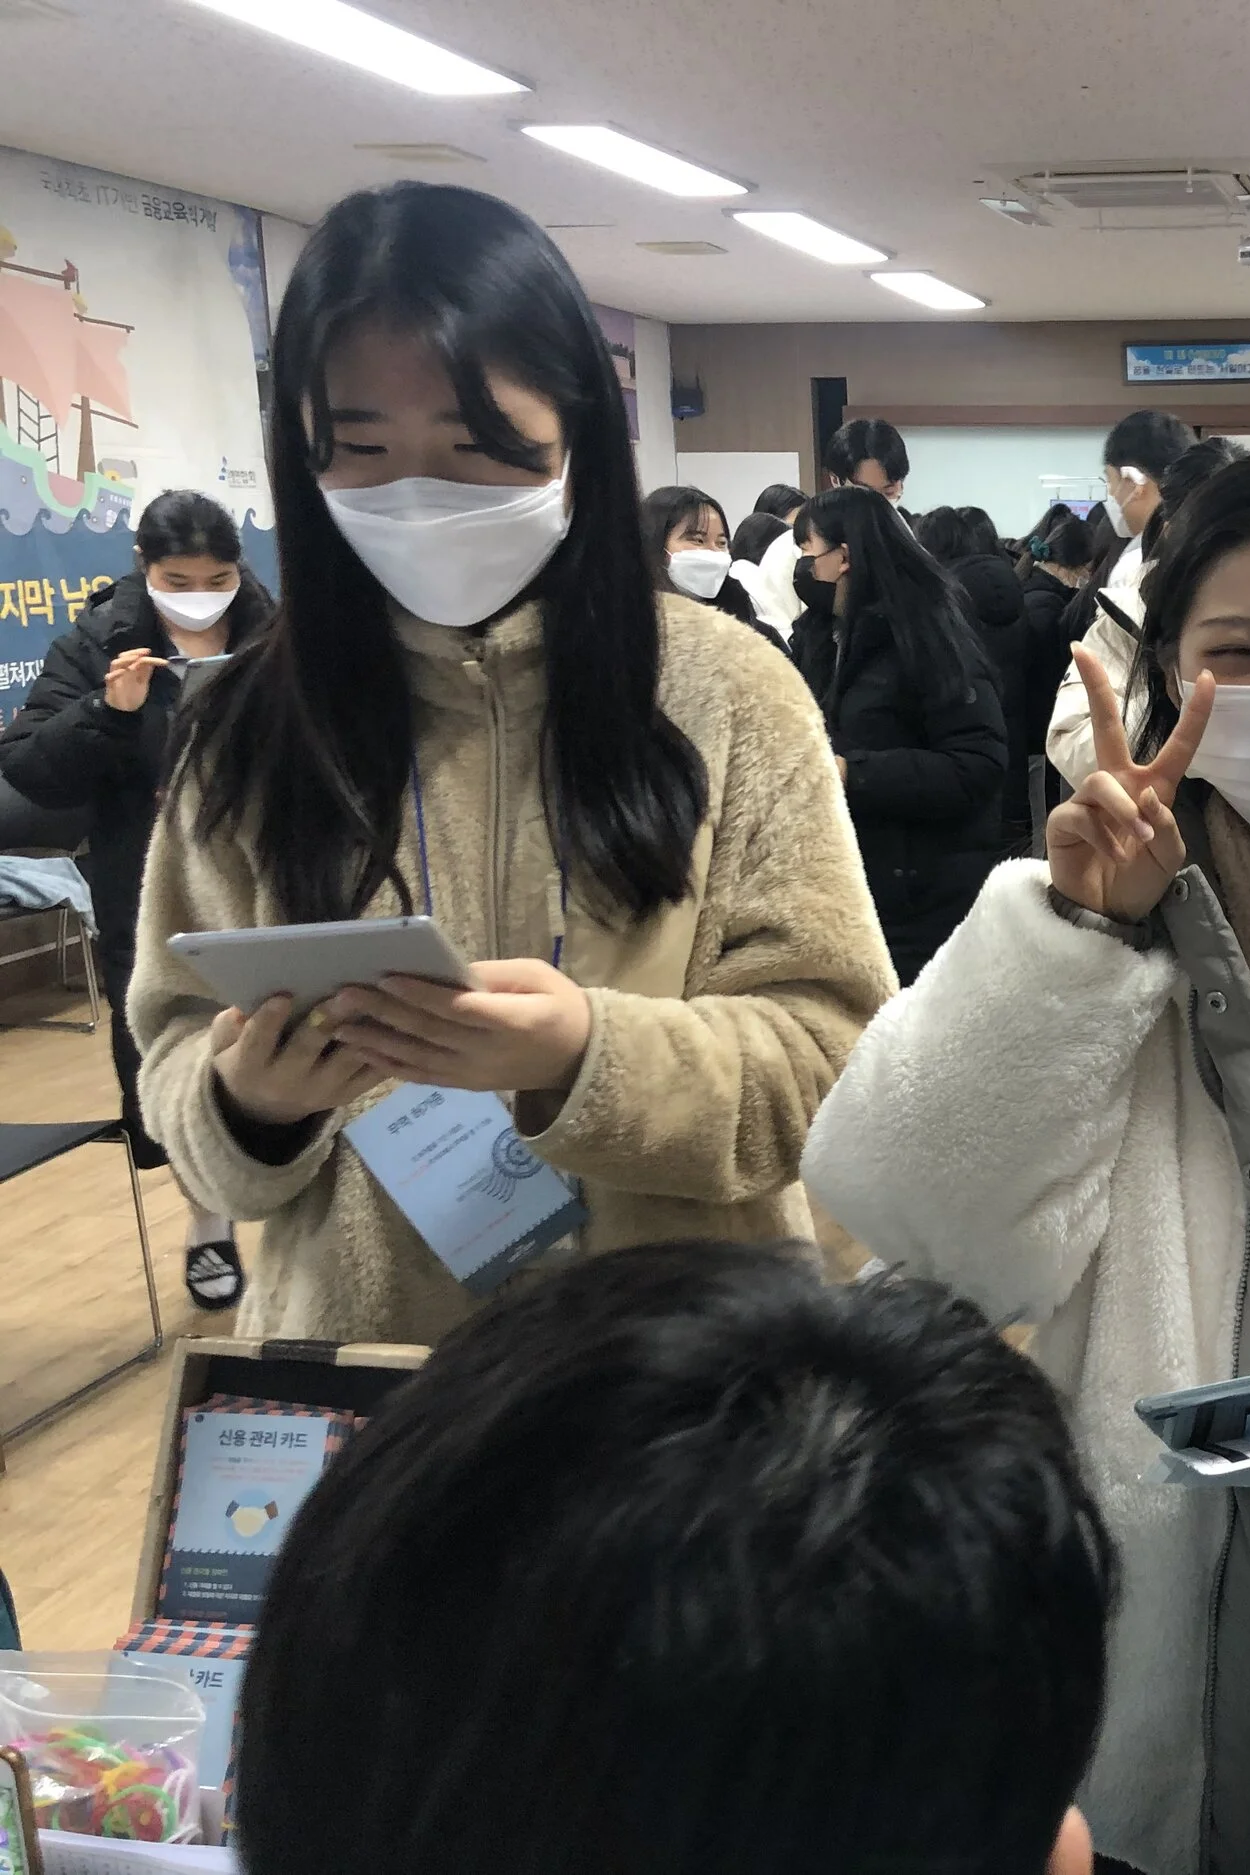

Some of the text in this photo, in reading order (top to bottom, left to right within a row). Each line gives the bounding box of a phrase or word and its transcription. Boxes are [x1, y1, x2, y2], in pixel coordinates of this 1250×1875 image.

[219, 1429, 308, 1449] 신용 관리 카드
[195, 1669, 224, 1688] 카드
